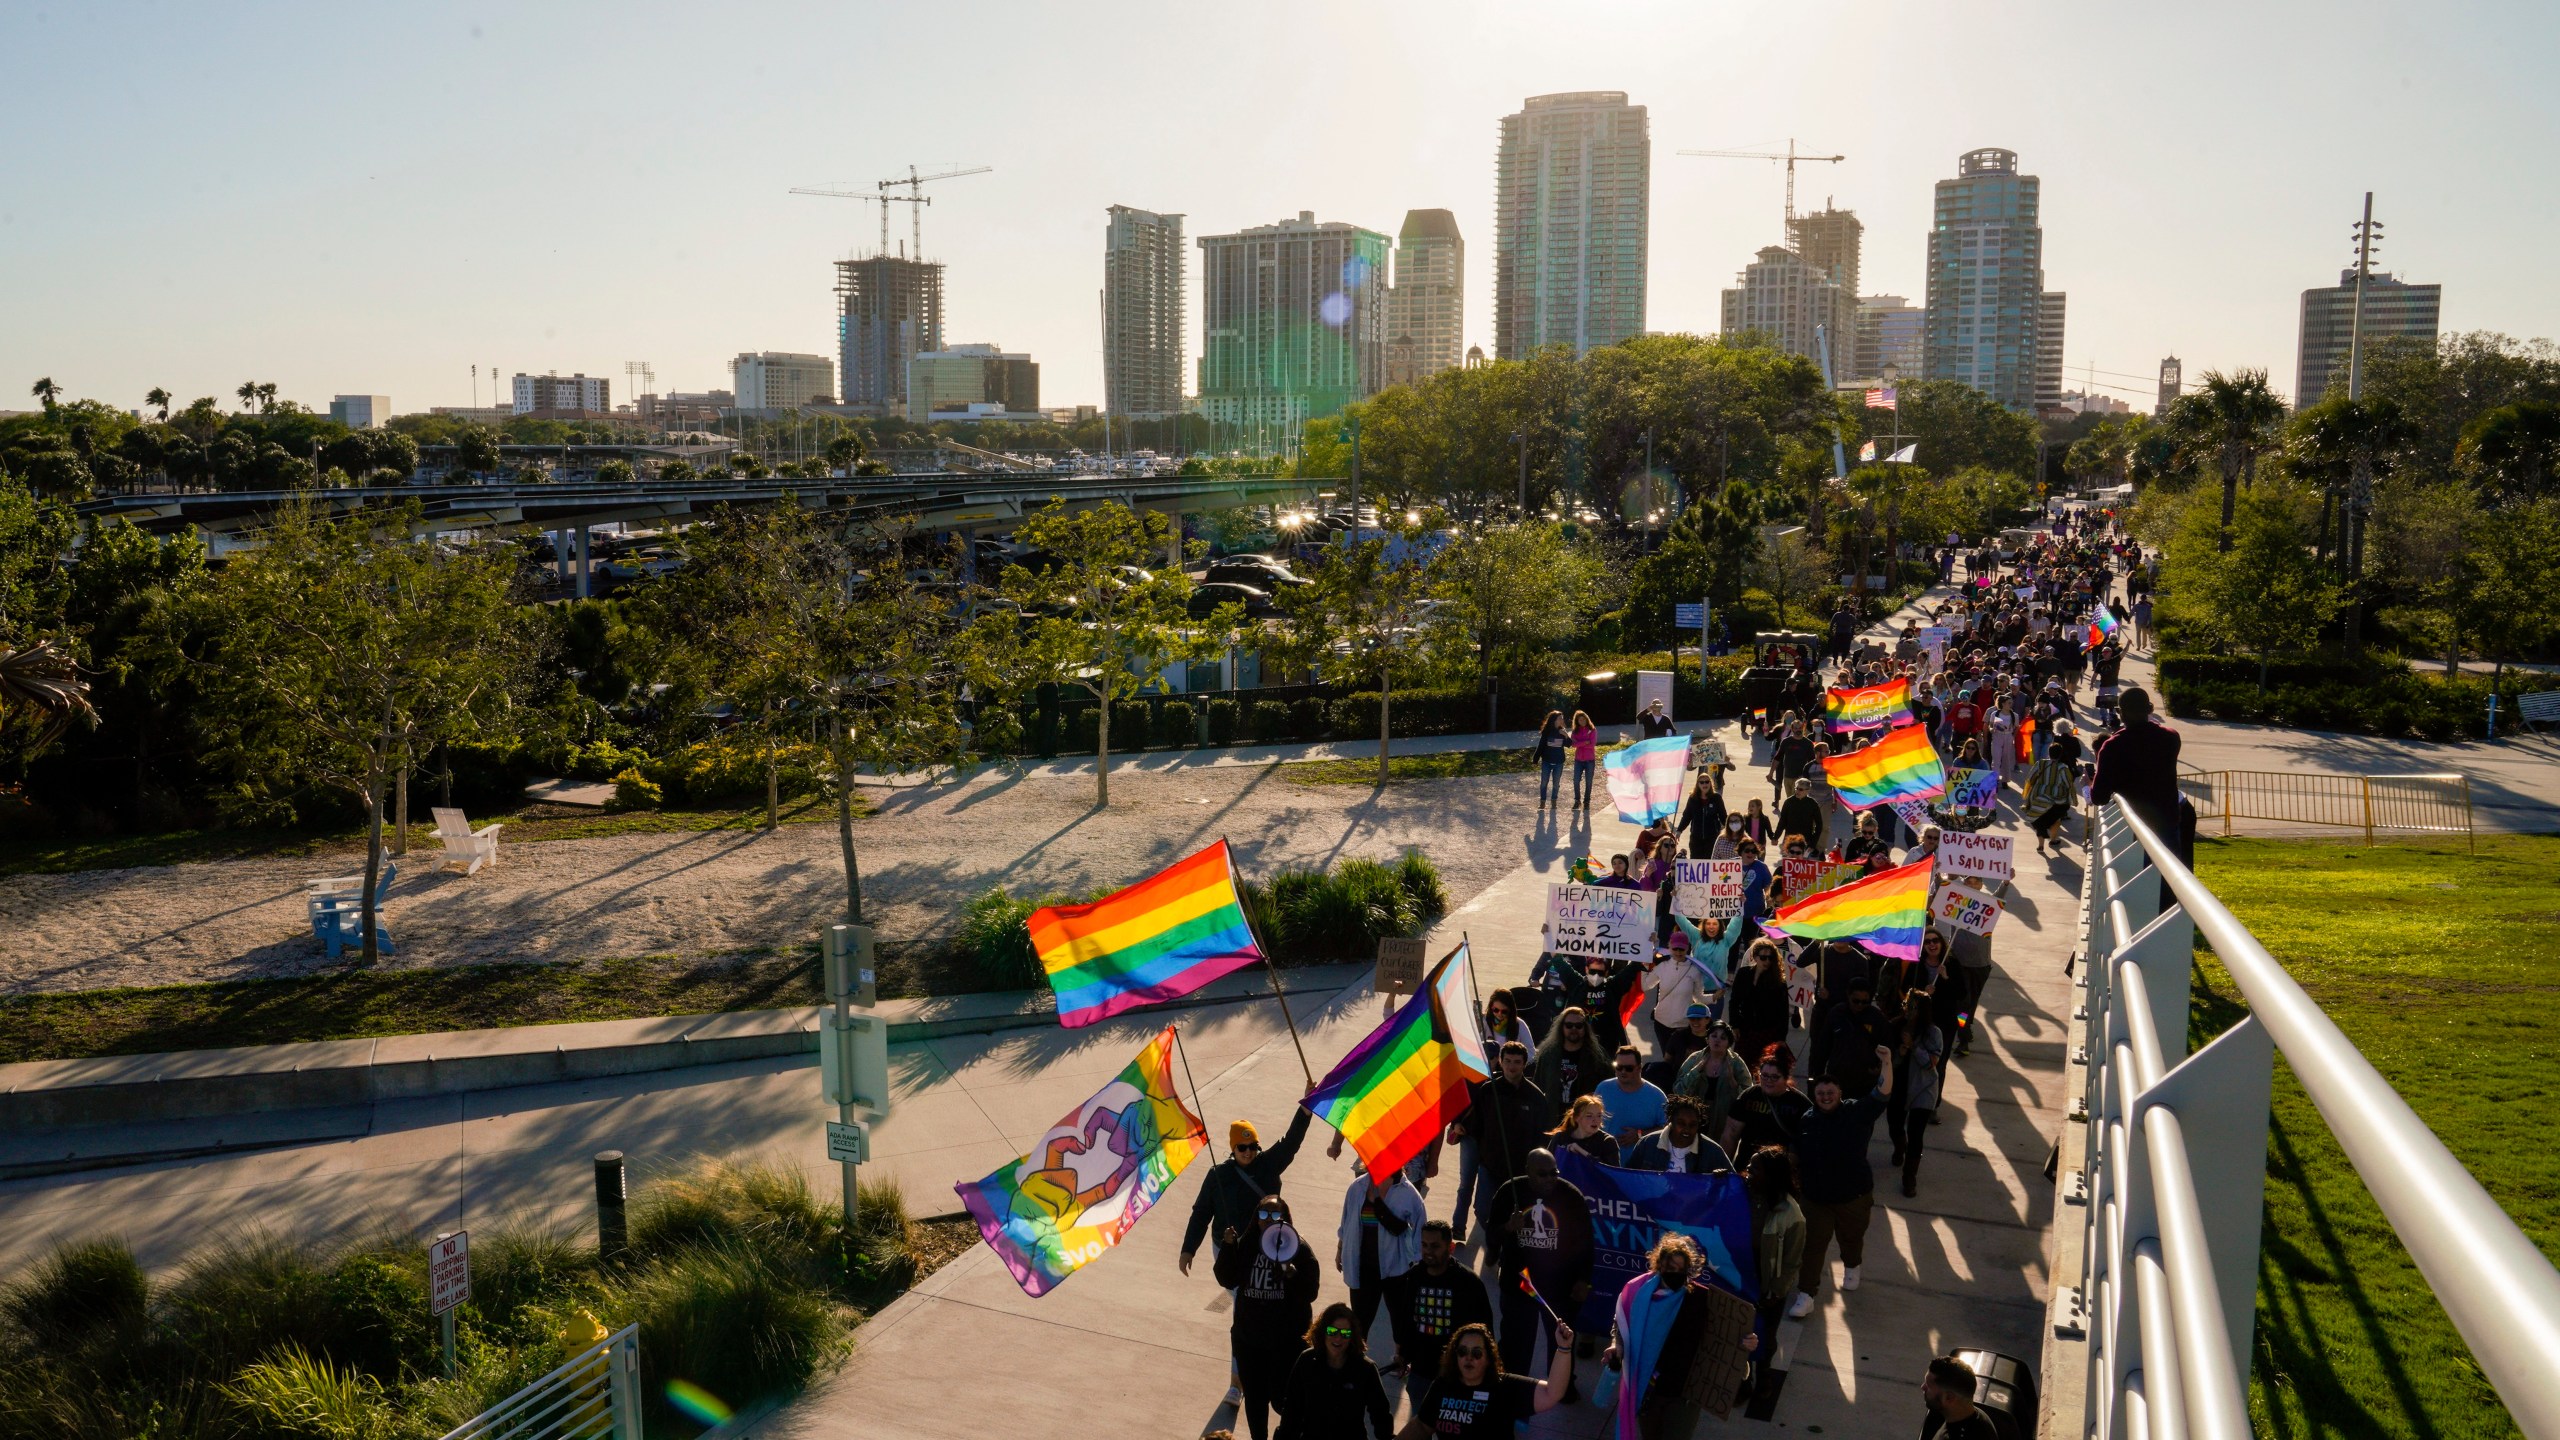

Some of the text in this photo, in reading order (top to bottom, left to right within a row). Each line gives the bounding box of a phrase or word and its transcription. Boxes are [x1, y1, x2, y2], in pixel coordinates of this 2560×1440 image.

[1855, 697, 1874, 706] LIVE
[1856, 705, 1883, 715] GREAT
[1855, 714, 1886, 723] STORY
[1954, 788, 1992, 806] GAY
[1942, 833, 2010, 851] GAY GAY GAY
[1712, 862, 1742, 872] LGBTQ
[1784, 860, 1814, 874] DON'T
[1816, 862, 1834, 876] LET
[1948, 854, 2007, 874] I SAID IT!
[1677, 862, 1710, 884] TEACH
[1784, 873, 1813, 890] TEACH
[1558, 887, 1644, 908] HEATHER
[1712, 884, 1743, 896] RIGHTS
[1785, 888, 1794, 897] TO
[1710, 898, 1743, 909] PROTECT
[1947, 892, 1995, 916] PROUD TO
[1560, 904, 1626, 928] already
[1710, 908, 1742, 918] OUR KIDS
[1942, 904, 1990, 929] SAY GAY
[1558, 923, 1622, 938] has 2
[1555, 938, 1641, 954] MOMMIES
[1380, 957, 1396, 968] OUR
[834, 1139, 856, 1148] ACCESS
[842, 1134, 858, 1142] RAMP
[442, 1240, 456, 1258] NO
[436, 1264, 464, 1284] PARKING
[436, 1274, 466, 1296] ANY TIME
[436, 1286, 468, 1310] FIRE LANE
[1708, 1290, 1749, 1325] THIS
[1706, 1309, 1746, 1352] BILL
[1700, 1340, 1740, 1371] WILL
[1692, 1353, 1732, 1393] KILL
[1685, 1376, 1730, 1414] KIDS
[1441, 1397, 1488, 1414] PROTECT
[1438, 1409, 1473, 1424] TRANS
[1436, 1420, 1462, 1434] KIDS
